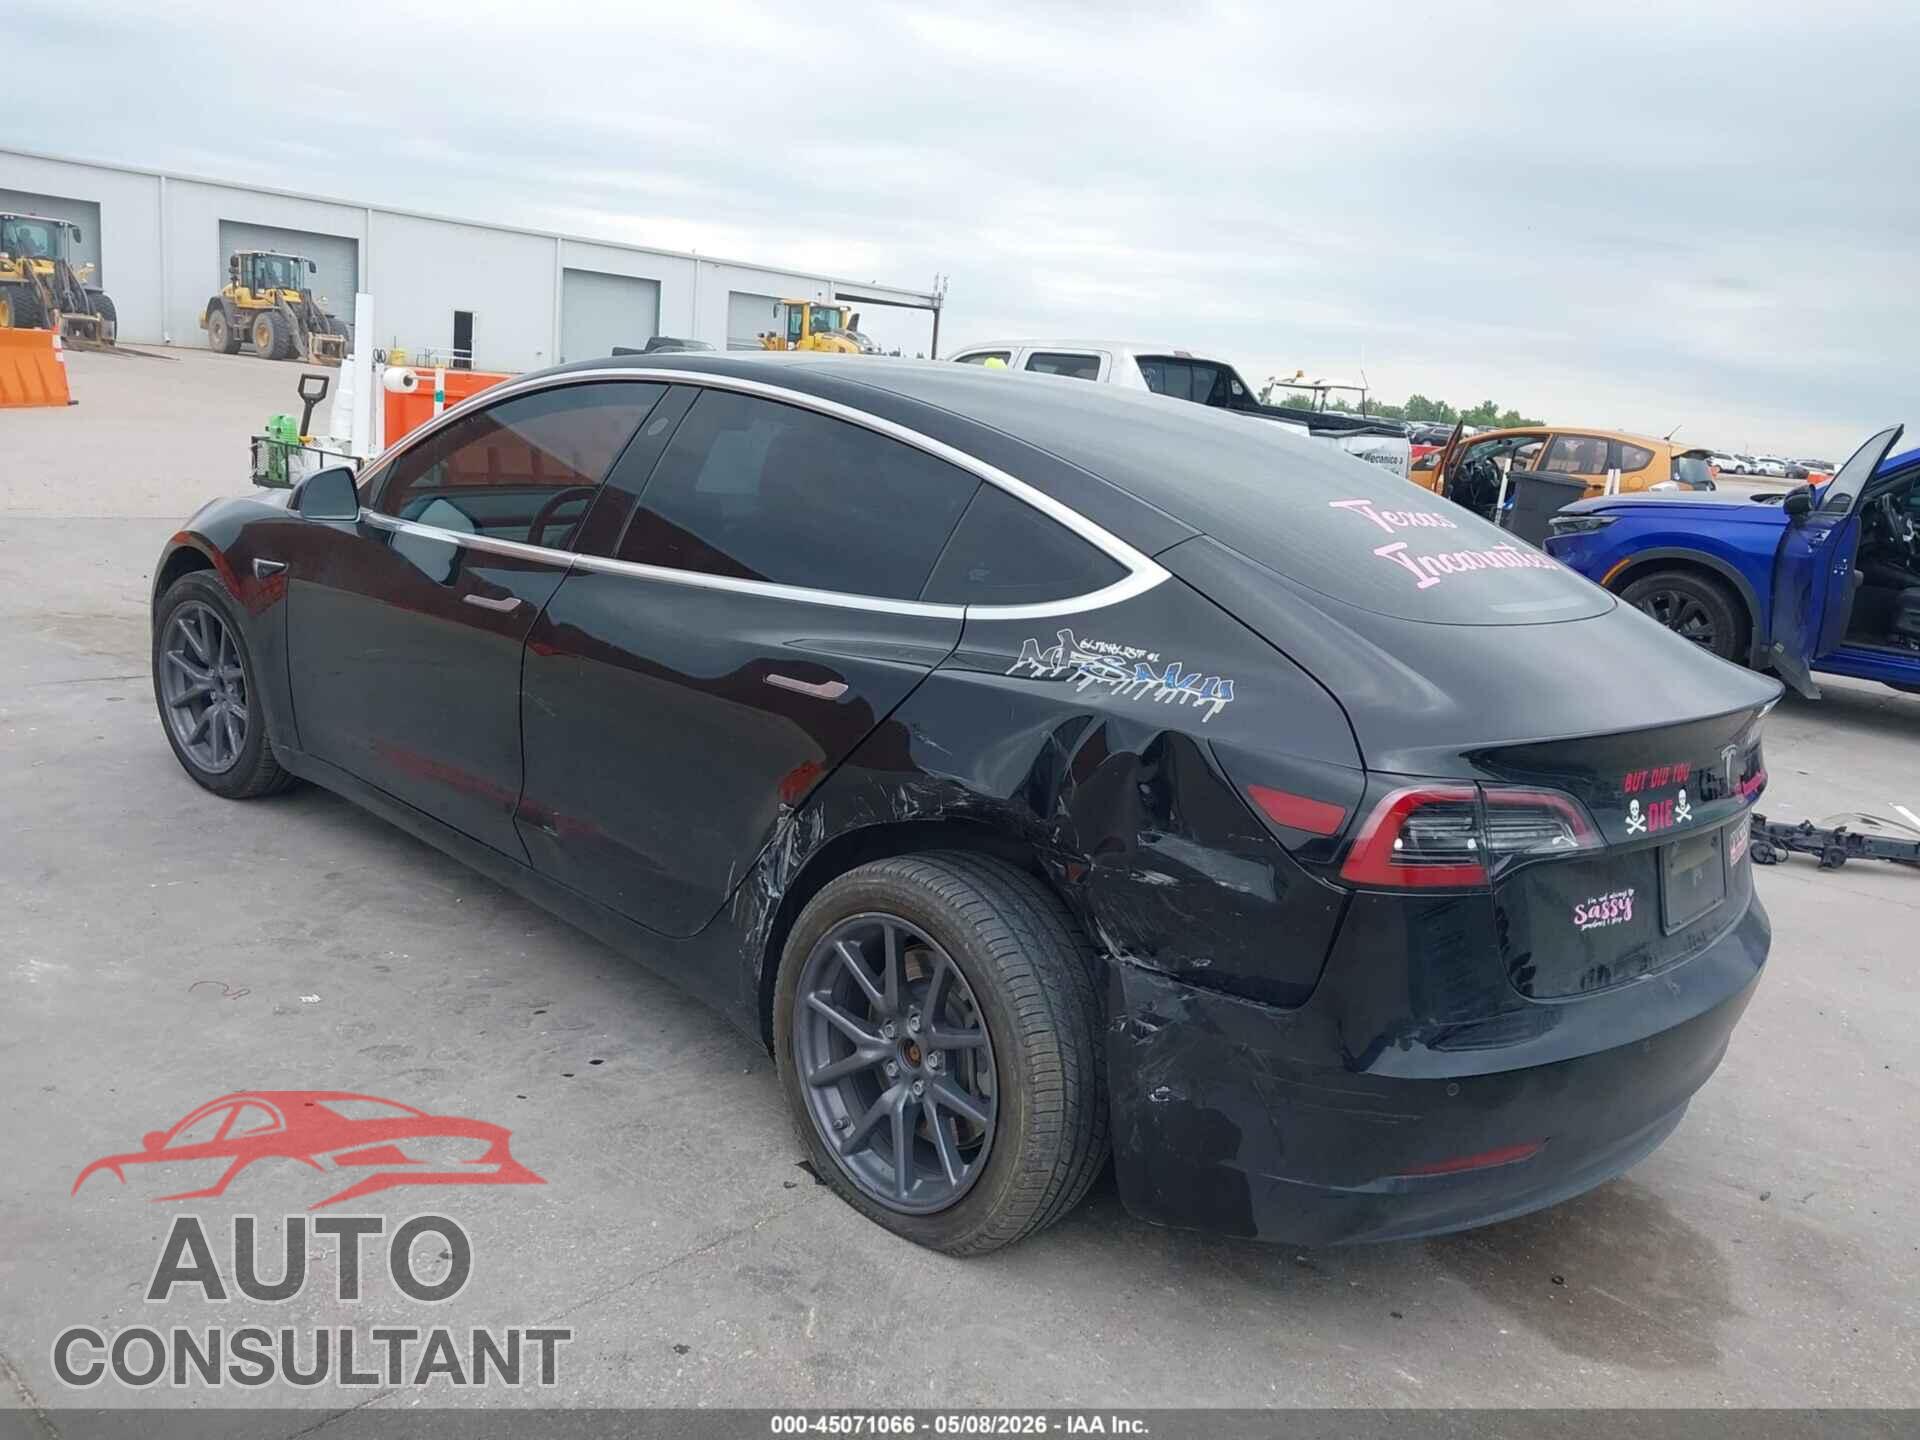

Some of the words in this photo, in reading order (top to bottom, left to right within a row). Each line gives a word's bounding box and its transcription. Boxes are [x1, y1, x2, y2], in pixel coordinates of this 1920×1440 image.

[1328, 498, 1457, 533] Texas
[1624, 770, 1649, 793] BUT
[1650, 766, 1671, 788] DID
[1647, 799, 1674, 832] DIE
